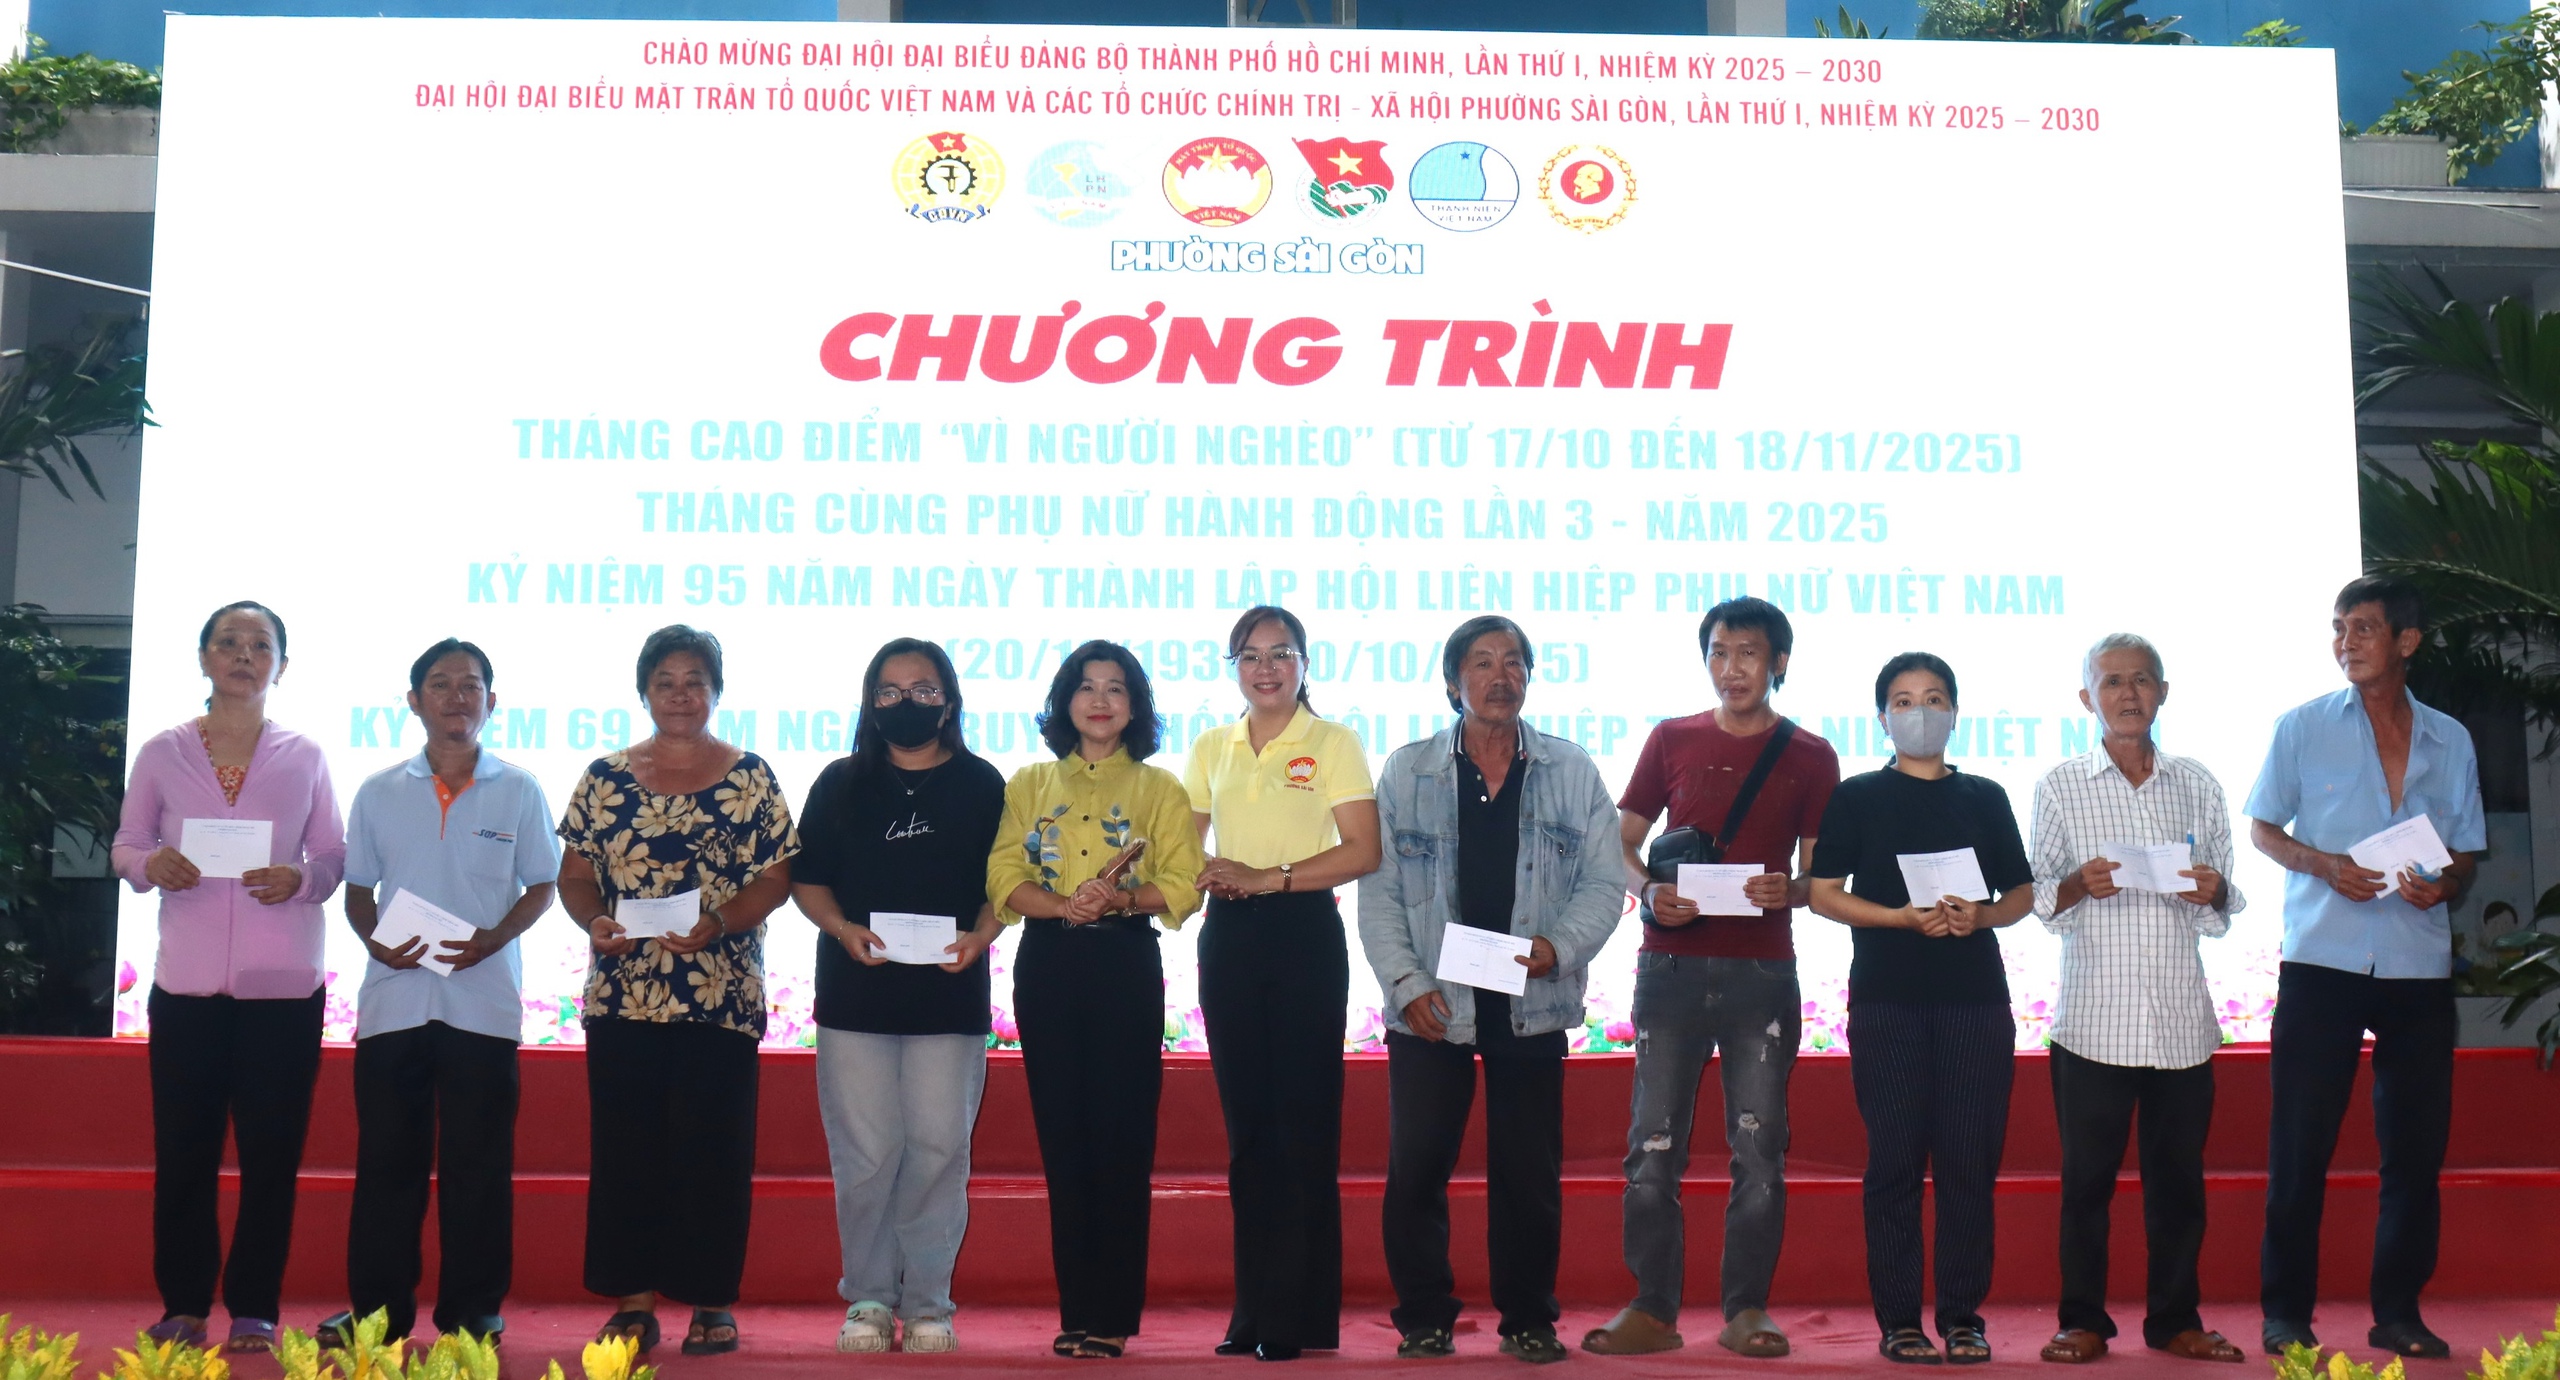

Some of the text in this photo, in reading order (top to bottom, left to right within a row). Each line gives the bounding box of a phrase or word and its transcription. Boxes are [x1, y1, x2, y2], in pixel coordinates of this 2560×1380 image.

[643, 38, 709, 66] CHÀO
[719, 38, 792, 67] MỪNG
[801, 43, 842, 71] ĐẠI
[852, 40, 893, 72] HỘI
[903, 45, 943, 71] ĐẠI
[954, 36, 1010, 69] BIỂU
[1020, 41, 1086, 70] ĐẢNG
[1096, 43, 1129, 75] BỘ
[1138, 44, 1218, 71] THÀNH
[1228, 41, 1277, 73] PHỐ
[1287, 41, 1320, 73] HỒ
[1329, 45, 1370, 74] CHÍ
[1381, 51, 1454, 80] MINH,
[1465, 41, 1509, 76] LẦN
[1518, 50, 1566, 77] THỨ
[1574, 55, 1590, 82] I,
[1599, 53, 1677, 83] NHIỆM
[1688, 52, 1715, 80] KỲ
[1725, 57, 1785, 82] 2025
[1822, 59, 1882, 84] 2030
[415, 83, 455, 112] ĐẠI
[466, 80, 507, 113] HỘI
[517, 84, 557, 113] ĐẠI
[568, 76, 624, 110] BIỂU
[634, 82, 684, 114] MẶT
[695, 83, 756, 115] TRẬN
[766, 79, 794, 112] TỔ
[803, 81, 871, 113] QUỐC
[880, 85, 932, 118] VIỆT
[941, 90, 995, 113] NAM
[1006, 86, 1036, 114] VÀ
[1045, 87, 1093, 115] CÁC
[1102, 81, 1131, 116] TỔ
[1140, 89, 1207, 117] CHỨC
[1217, 88, 1294, 117] CHÍNH
[1304, 94, 1342, 123] TRỊ
[1371, 92, 1401, 119] XÃ
[1410, 92, 1451, 124] HỘI
[1461, 94, 1561, 122] PHƯỜNG
[1570, 94, 1608, 123] SÀI
[1618, 94, 1677, 128] GÒN,
[1687, 91, 1730, 124] LẦN
[1739, 100, 1786, 125] THỨ
[1795, 104, 1811, 131] I,
[1820, 100, 1898, 131] NHIỆM
[1908, 103, 1935, 128] KỲ
[1945, 106, 2004, 130] 2025
[2041, 108, 2100, 132] 2030
[1110, 235, 1425, 275] PHƯỜNG SÀI GÒN
[819, 298, 1735, 392] CHƯƠNG TRÌNH
[512, 412, 670, 460] THÁNG
[690, 420, 783, 462] CAO
[803, 406, 921, 462] ĐIỂM
[1029, 417, 1175, 466] NGƯỜI
[1393, 421, 1473, 468] (TỪ
[1488, 428, 1610, 469] 17/10
[1629, 416, 1717, 470] ĐẾN
[1735, 430, 2021, 474] 18/11/2025)
[636, 486, 794, 534] THÁNG
[815, 486, 946, 535] CÙNG
[967, 494, 1061, 544] PHỤ
[1083, 490, 1150, 538] NỮ
[1165, 490, 1293, 538] HÀNH
[1312, 490, 1443, 547] ĐỘNG
[1463, 485, 1546, 540] LẦN
[1565, 499, 1594, 541] 3
[1646, 494, 1748, 541] NĂM
[1768, 501, 1889, 543] 2025
[468, 552, 527, 603] KỶ
[546, 556, 664, 613] NIỆM
[684, 564, 746, 606] 95
[767, 558, 872, 606] NĂM
[892, 560, 1017, 608] NGÀY
[1036, 561, 1194, 609] THÀNH
[1215, 562, 1297, 619] LẬP
[1316, 562, 1397, 618] HỘI
[1418, 563, 1513, 611] LIÊN
[1533, 564, 1636, 621] HIỆP
[1768, 566, 1833, 614] NỮ
[1846, 566, 1945, 623] VIỆT
[1964, 574, 2065, 615] NAM
[350, 695, 411, 748] KỶ
[567, 708, 631, 752] 69
